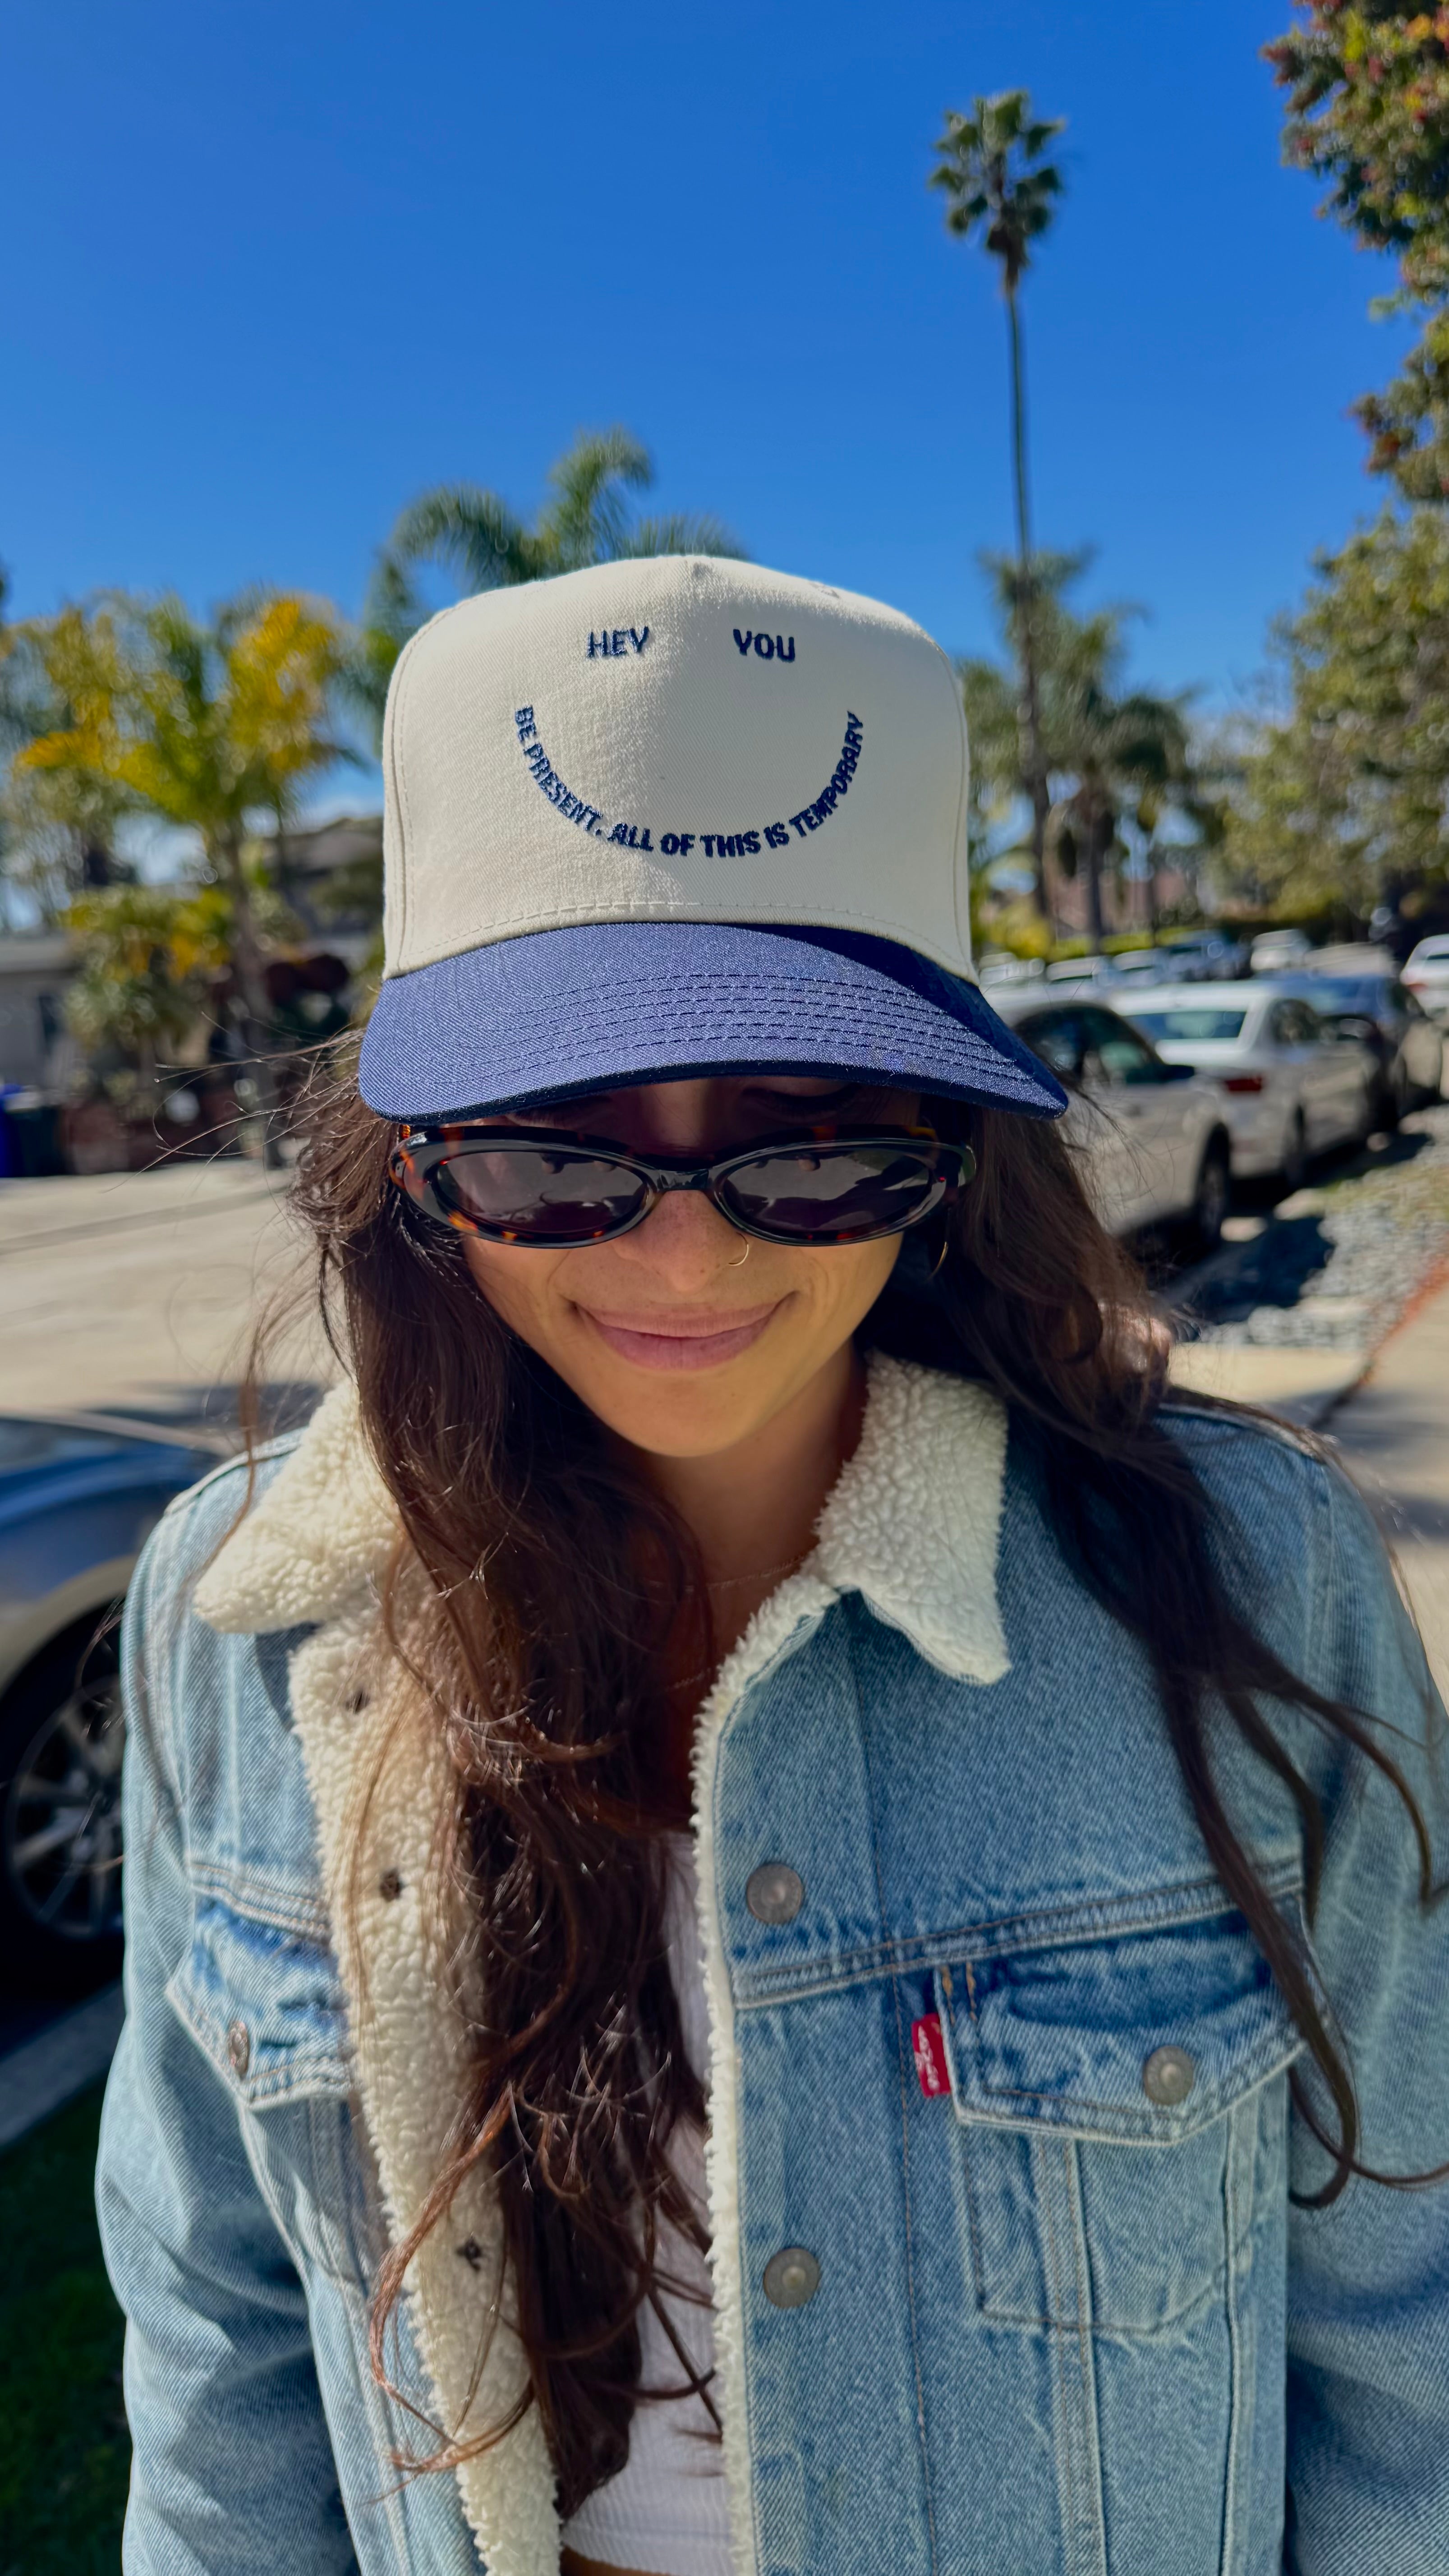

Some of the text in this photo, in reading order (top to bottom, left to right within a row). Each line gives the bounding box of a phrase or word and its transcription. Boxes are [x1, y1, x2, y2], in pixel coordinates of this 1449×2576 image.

[587, 626, 796, 663] HEY YOU
[515, 705, 863, 858] BE PRESENT. ALL OF THIS IS TEMPORARY
